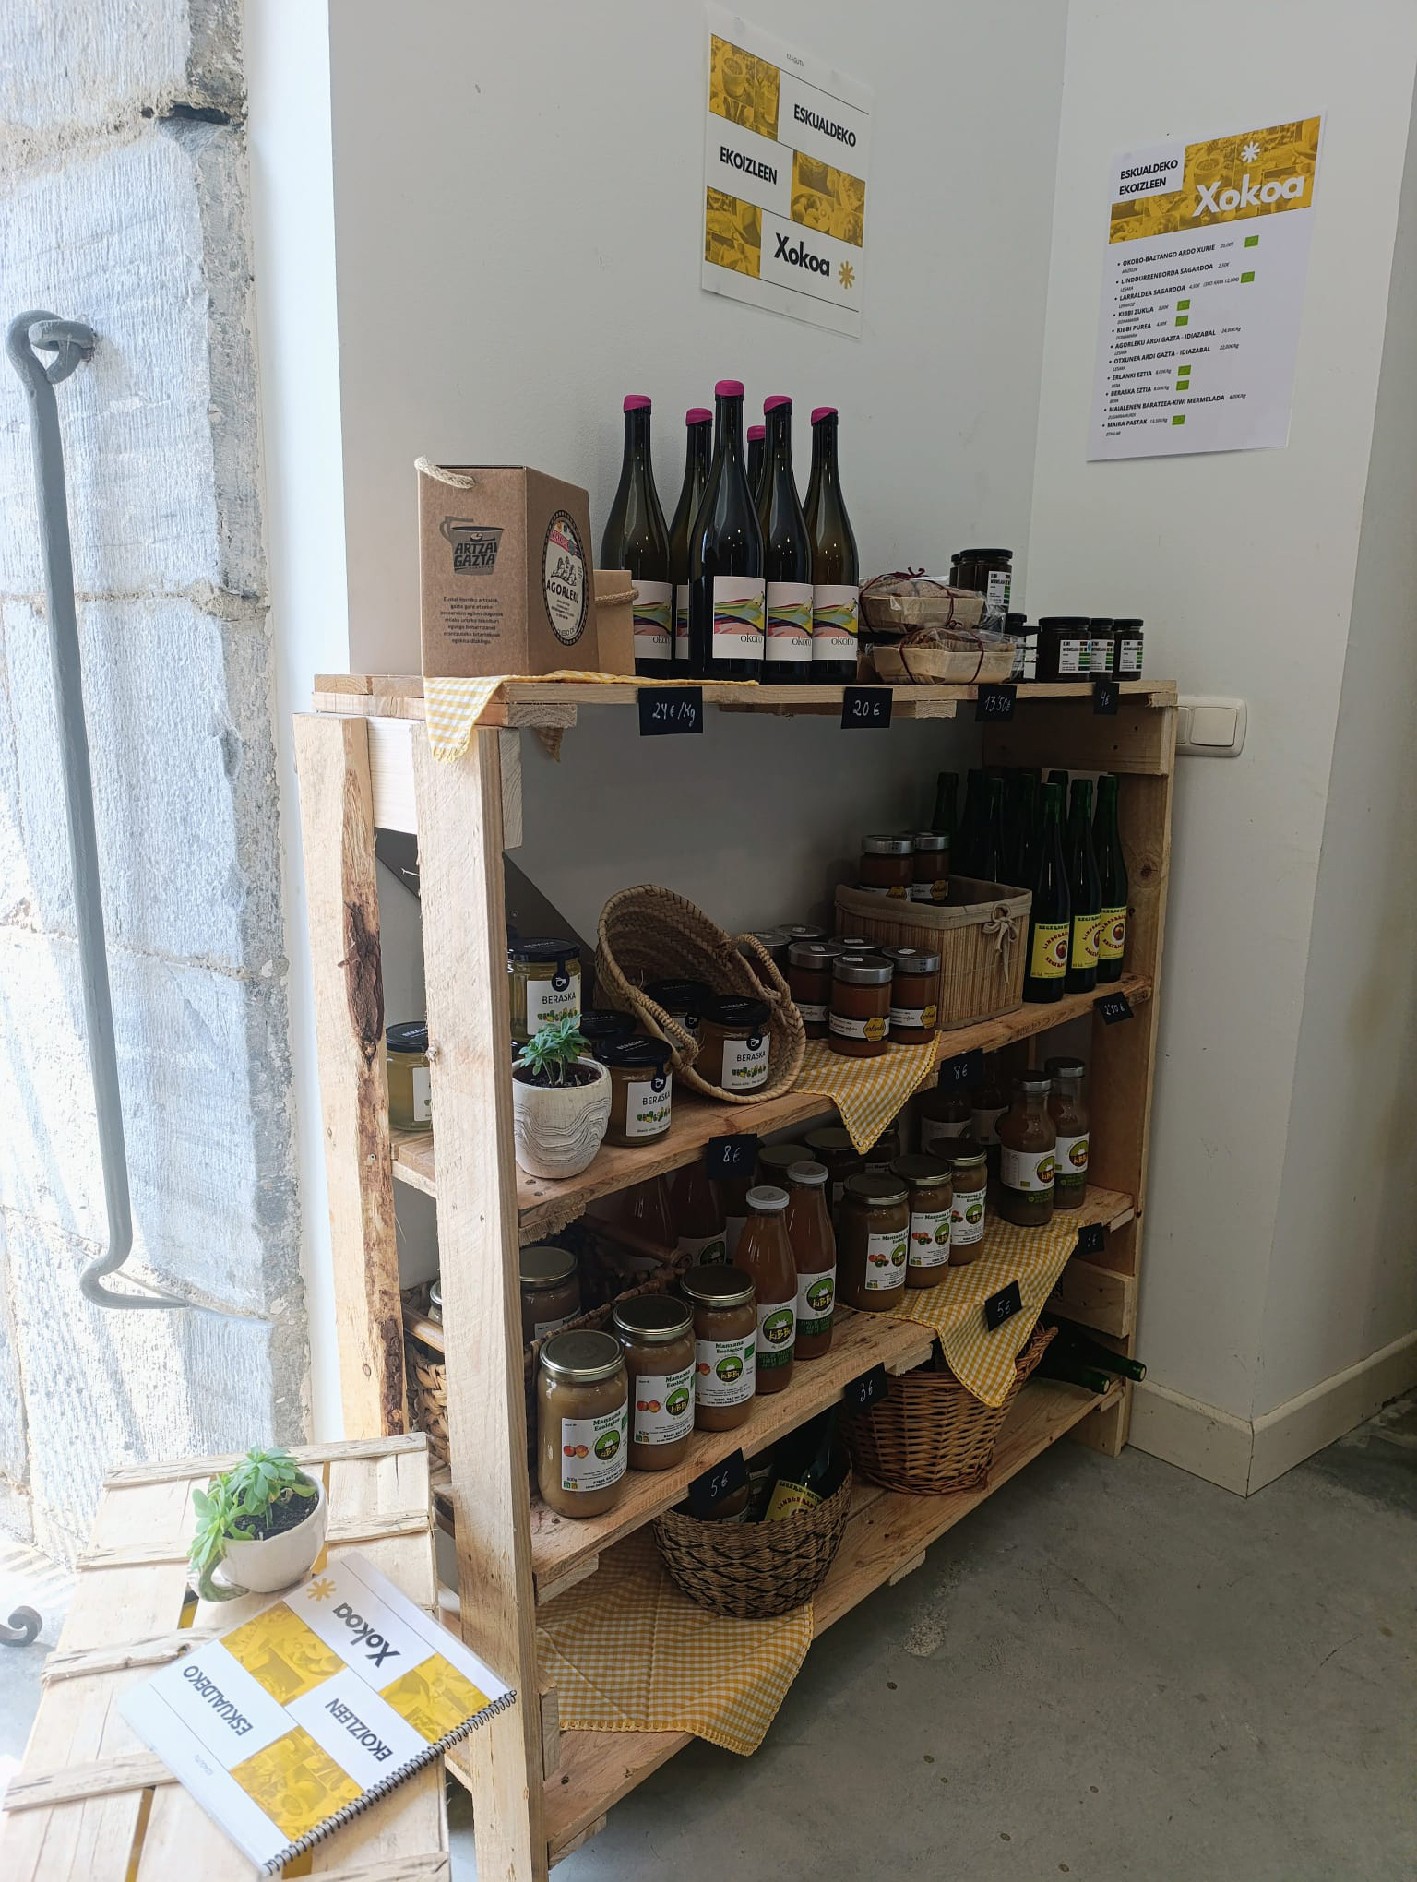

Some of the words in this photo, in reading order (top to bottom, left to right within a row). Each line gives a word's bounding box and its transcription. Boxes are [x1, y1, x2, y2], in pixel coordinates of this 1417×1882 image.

[794, 104, 856, 148] ESKUALDEKO
[720, 147, 777, 185] EKOIZLEEN
[1120, 159, 1178, 180] ESKUALDEKO
[1119, 177, 1167, 195] EKOIZLEEN
[1192, 174, 1304, 217] Xokoa
[774, 232, 830, 277] Xokoa
[1180, 263, 1213, 274] SAGARDOA
[1153, 285, 1186, 296] SAGARDOA
[1161, 334, 1180, 344] GAZTA
[1184, 330, 1216, 340] IDIAZABAL
[1157, 350, 1175, 359] GAZTA
[1187, 394, 1226, 405] MERMELADA
[454, 541, 497, 555] ARTZAI
[454, 553, 495, 567] GAZTA
[541, 992, 576, 1005] BERASKA
[737, 1050, 766, 1062] BERASKA
[643, 1090, 671, 1106] BERASKA
[723, 1144, 741, 1163] 8€
[996, 1298, 1011, 1319] 5€
[710, 1470, 729, 1497] 5€
[332, 1602, 400, 1668] Xokoa
[182, 1664, 254, 1737] ESKUALDEKO
[324, 1697, 393, 1762] EKOIZLEEN
